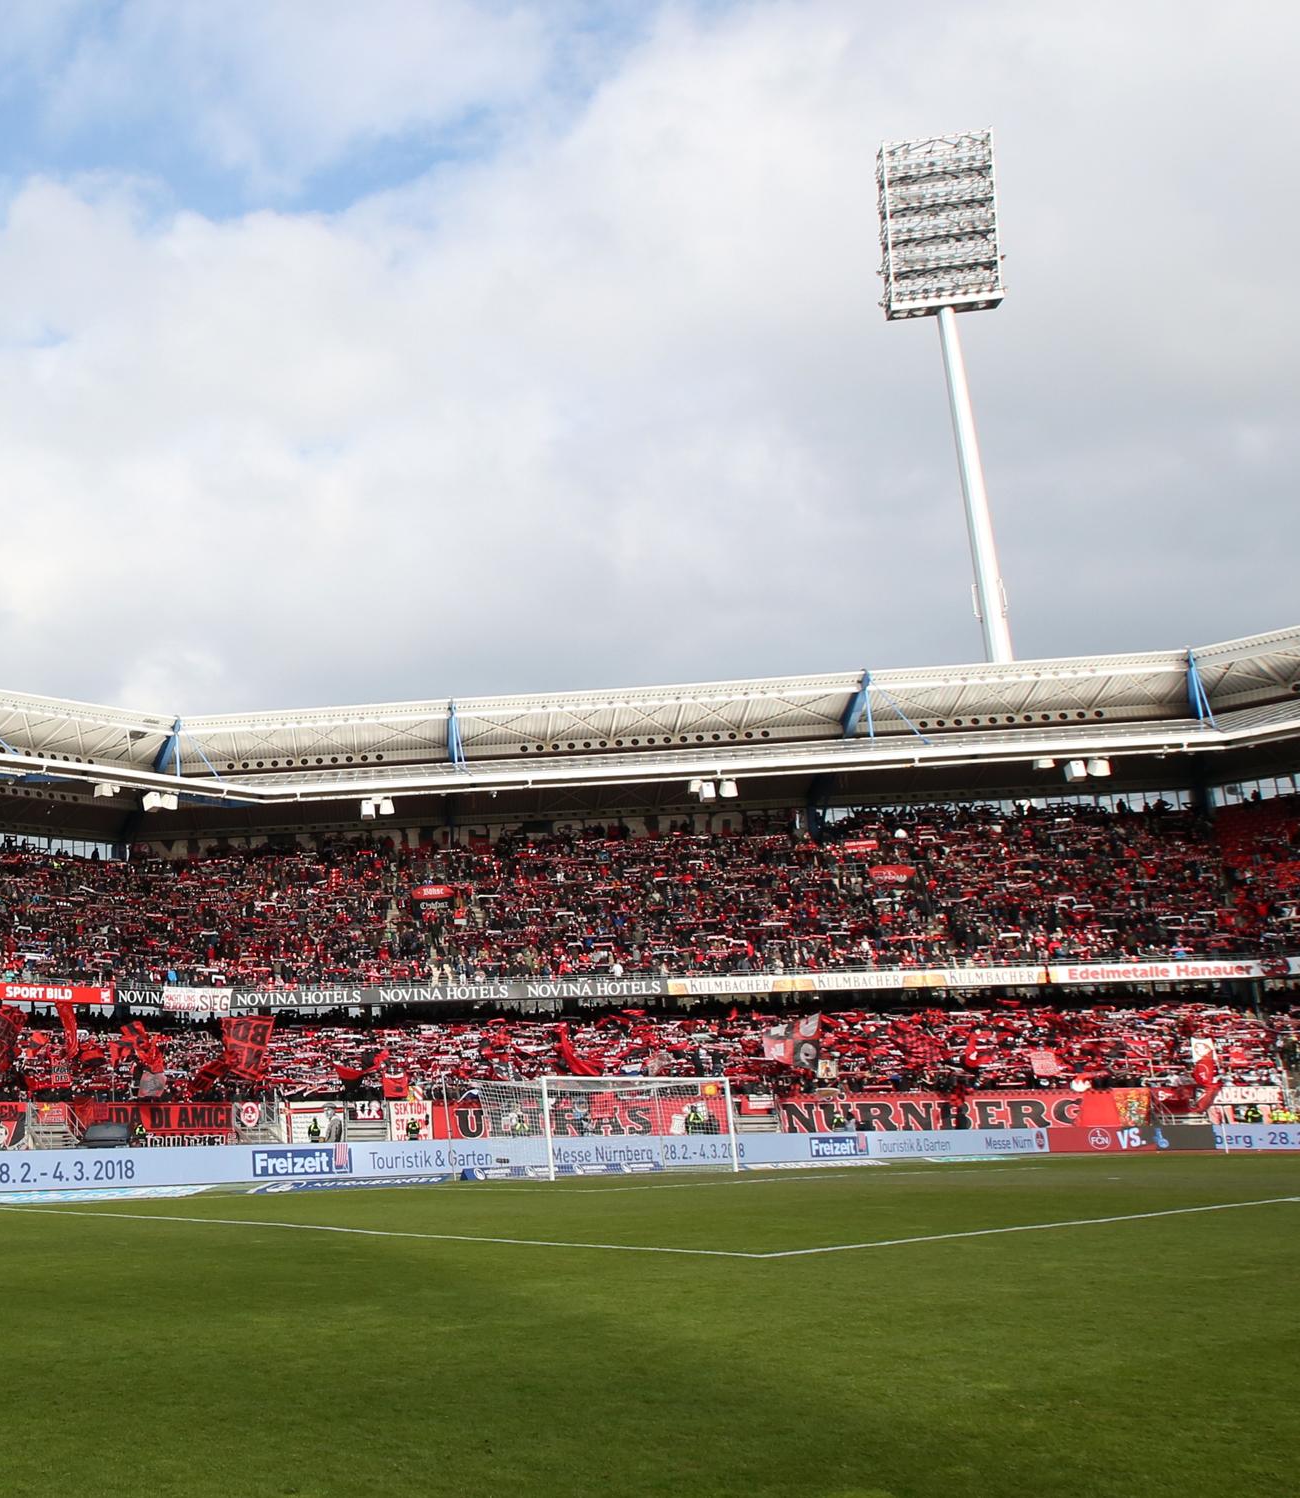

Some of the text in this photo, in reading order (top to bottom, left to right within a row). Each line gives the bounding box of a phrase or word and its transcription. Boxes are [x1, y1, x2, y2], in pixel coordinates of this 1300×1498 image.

[950, 970, 1035, 985] KULMBACHER
[1067, 964, 1252, 981] Edelmetalle Hanauer
[527, 980, 661, 997] NOVINA HOTELS
[689, 979, 771, 993] KULMBACHER
[817, 974, 901, 989] KULMBACHER
[5, 986, 72, 1000] SPORT BILD
[118, 990, 165, 1004] NOVINA
[236, 990, 362, 1007] NOVINA HOTELS
[379, 986, 509, 1002] NOVINA HOTELS
[199, 994, 229, 1011] SIEG
[150, 1107, 171, 1128] DI
[177, 1107, 232, 1128] AMICI
[394, 1103, 428, 1115] SEKTION
[780, 1095, 1082, 1132] NÜRNBERG
[877, 1137, 951, 1153] Touristik & Garten
[985, 1136, 1011, 1150] Messe
[1090, 1136, 1110, 1145] FCN
[1116, 1127, 1147, 1149] VS.
[552, 1146, 592, 1163] Messe
[595, 1143, 653, 1164] Nürnberg
[810, 1139, 855, 1157] Freizeit
[254, 1151, 330, 1175] Freizeit
[369, 1149, 493, 1170] Touristik & Garten
